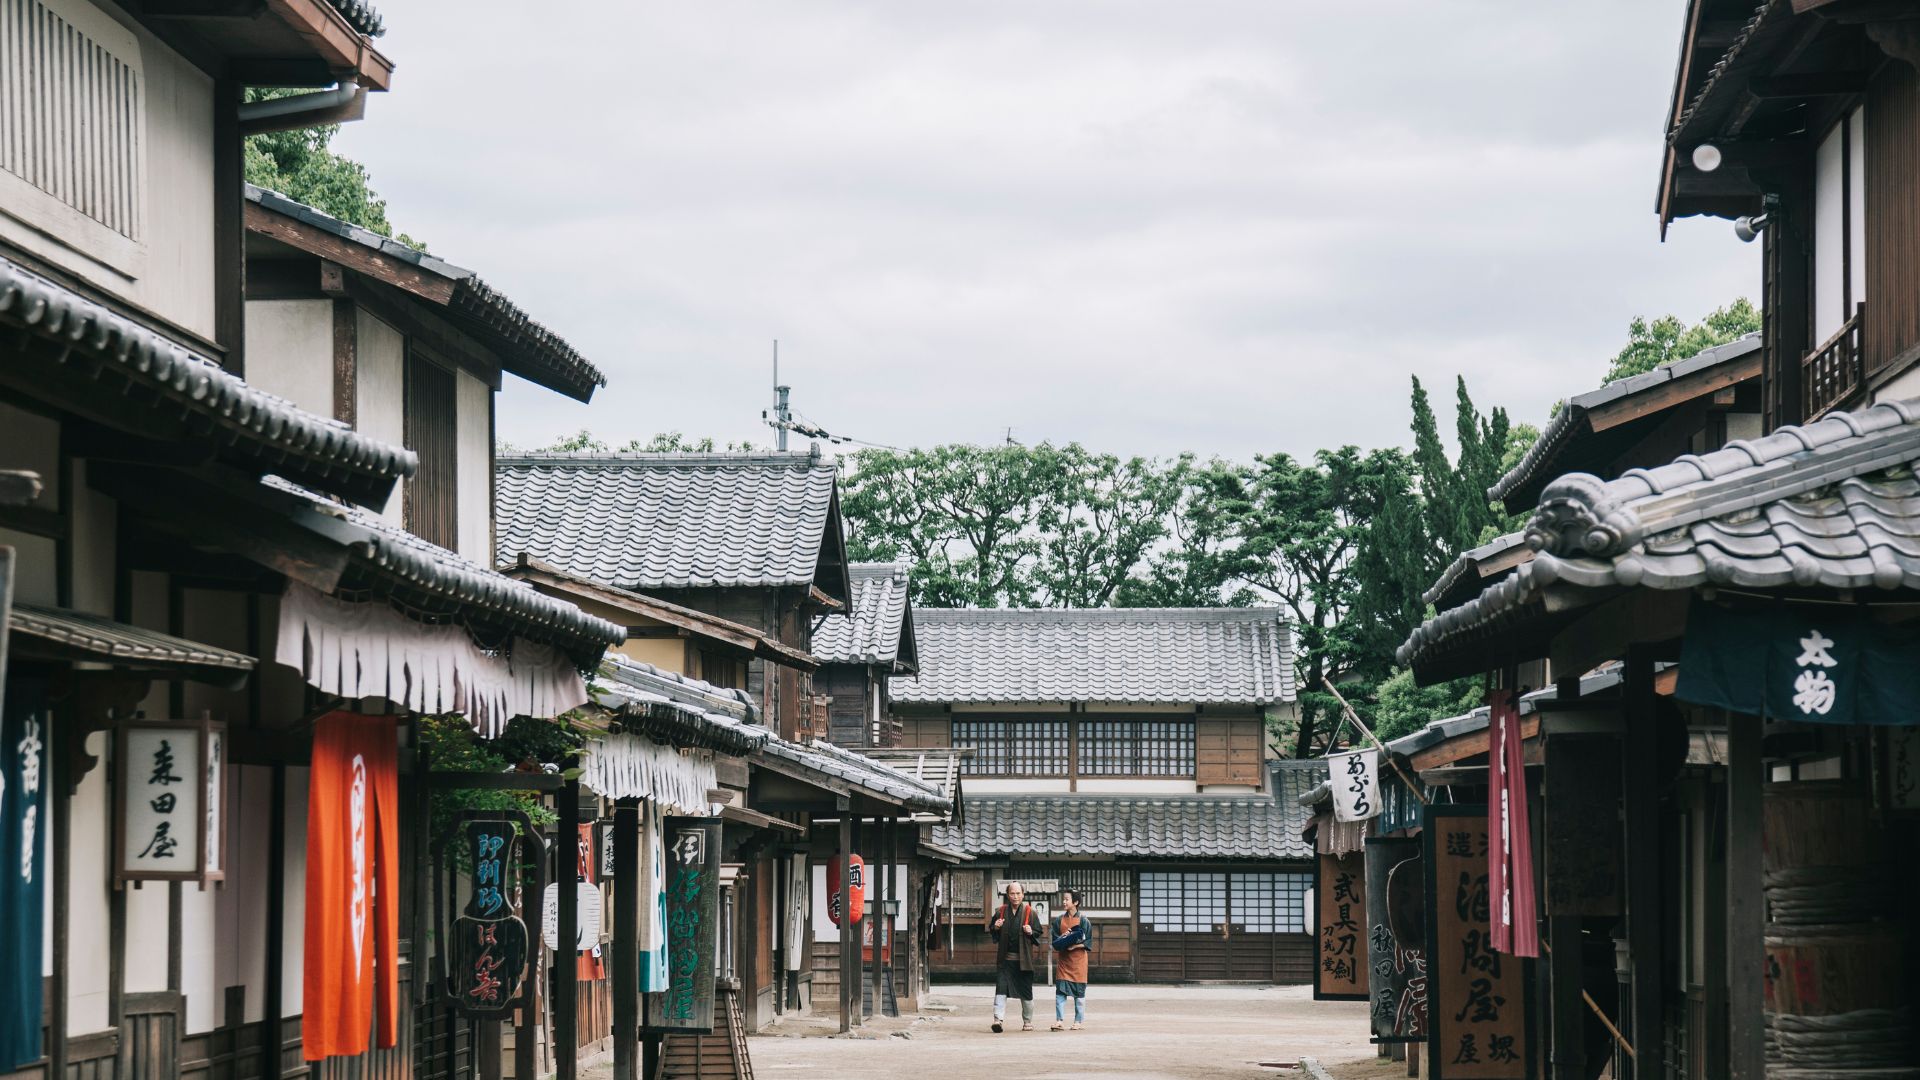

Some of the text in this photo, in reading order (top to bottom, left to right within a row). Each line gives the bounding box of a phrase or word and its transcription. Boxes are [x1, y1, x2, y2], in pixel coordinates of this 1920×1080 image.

[138, 740, 182, 859] 来田屋
[1346, 753, 1371, 817] あぶら
